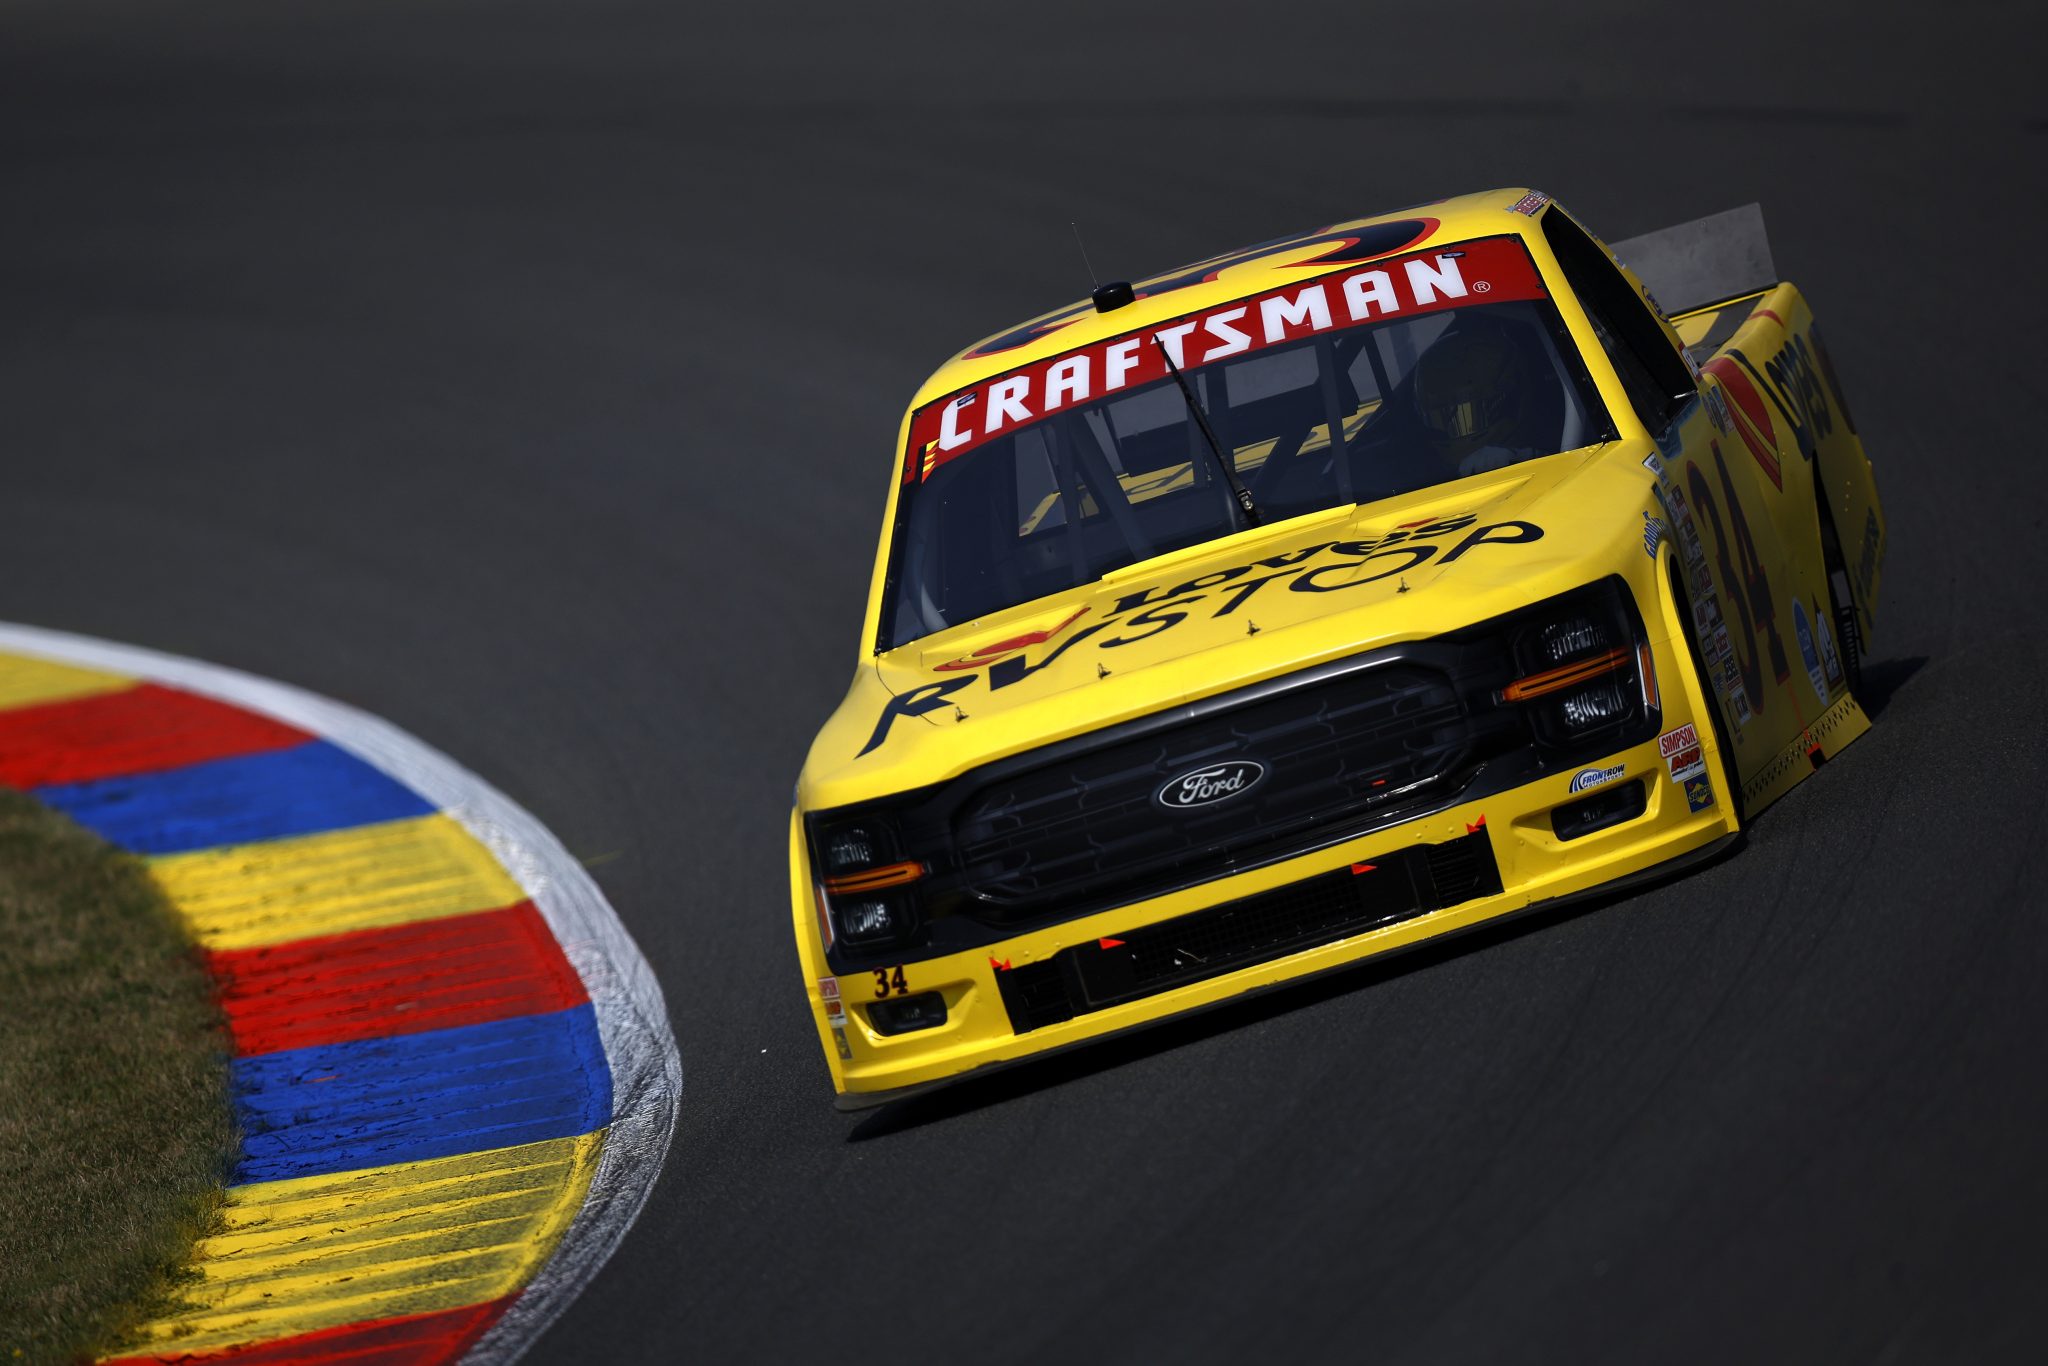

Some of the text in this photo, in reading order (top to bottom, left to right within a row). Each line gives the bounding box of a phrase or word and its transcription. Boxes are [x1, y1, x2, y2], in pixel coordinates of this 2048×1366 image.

[938, 253, 1469, 452] CRAFTSMAN
[1660, 725, 1697, 755] SIMPSON
[1179, 768, 1244, 803] Ford
[872, 963, 908, 998] 34
